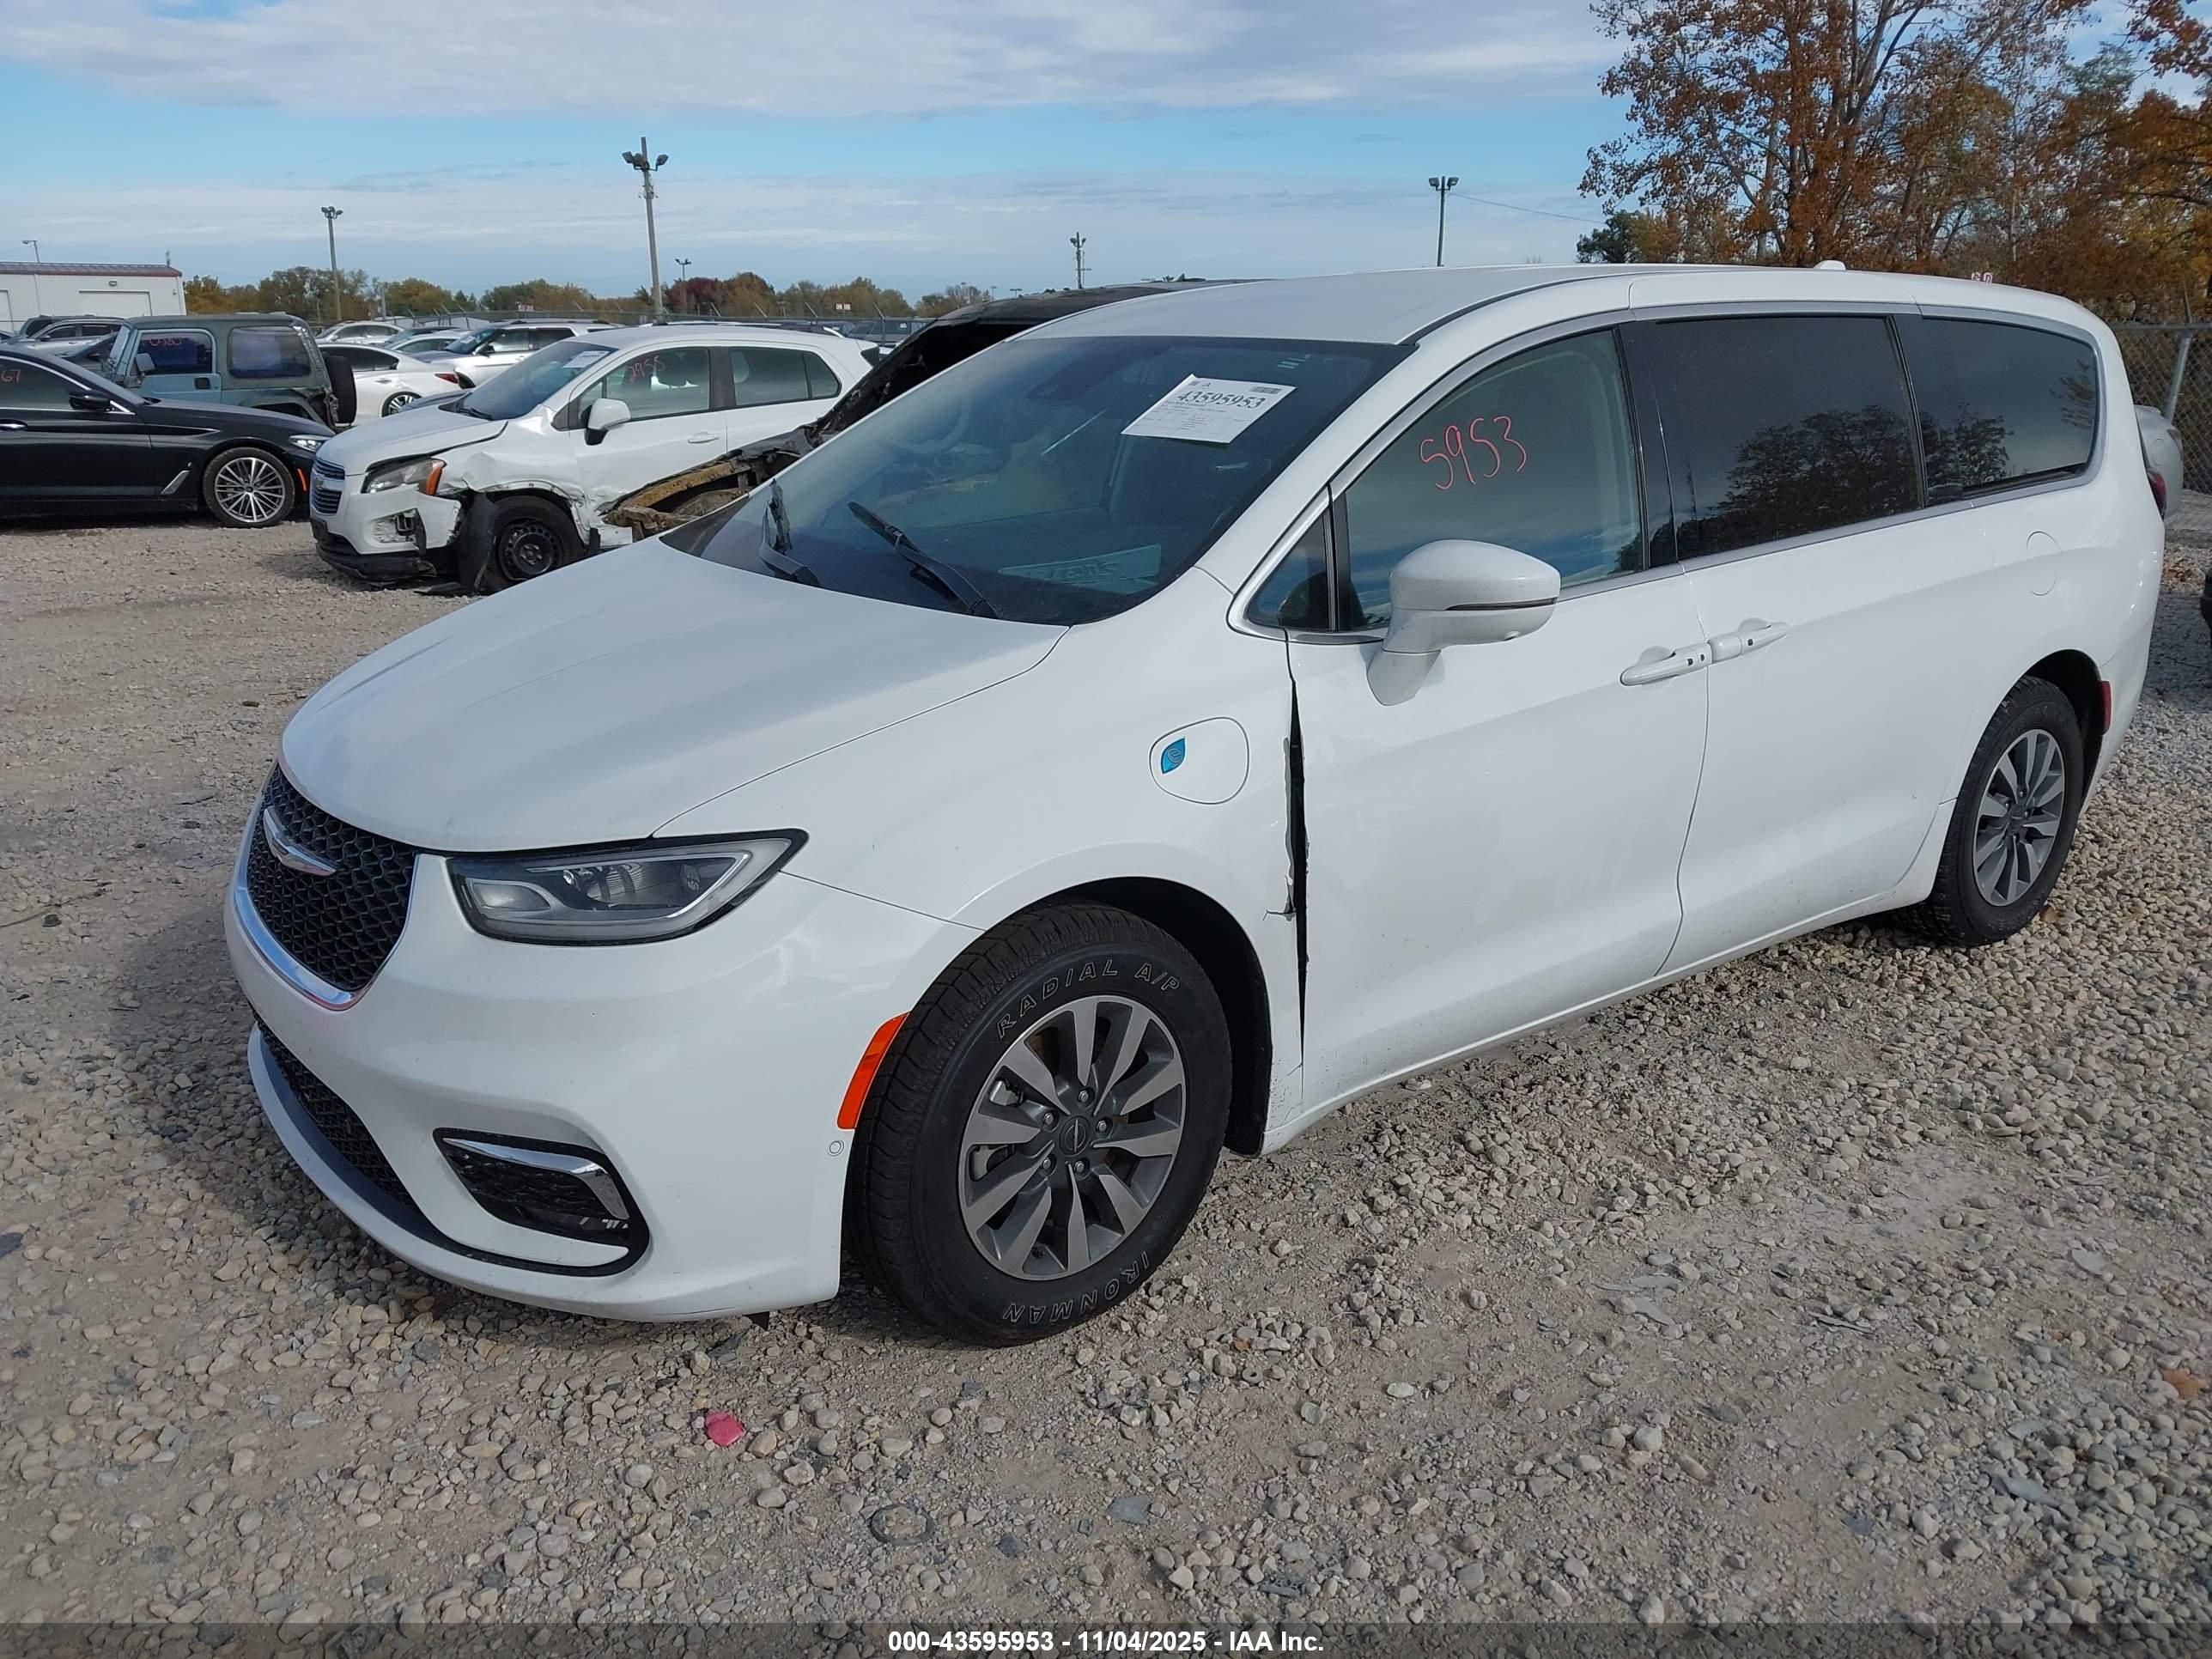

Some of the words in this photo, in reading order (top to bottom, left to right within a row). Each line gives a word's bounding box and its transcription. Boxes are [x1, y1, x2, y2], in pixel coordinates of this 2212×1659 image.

[1177, 391, 1267, 409] 43595953
[1419, 416, 1527, 489] 5953
[997, 959, 1118, 1039] RADIAL
[1134, 963, 1180, 991] A/P
[1003, 1251, 1149, 1324] IRONMAN
